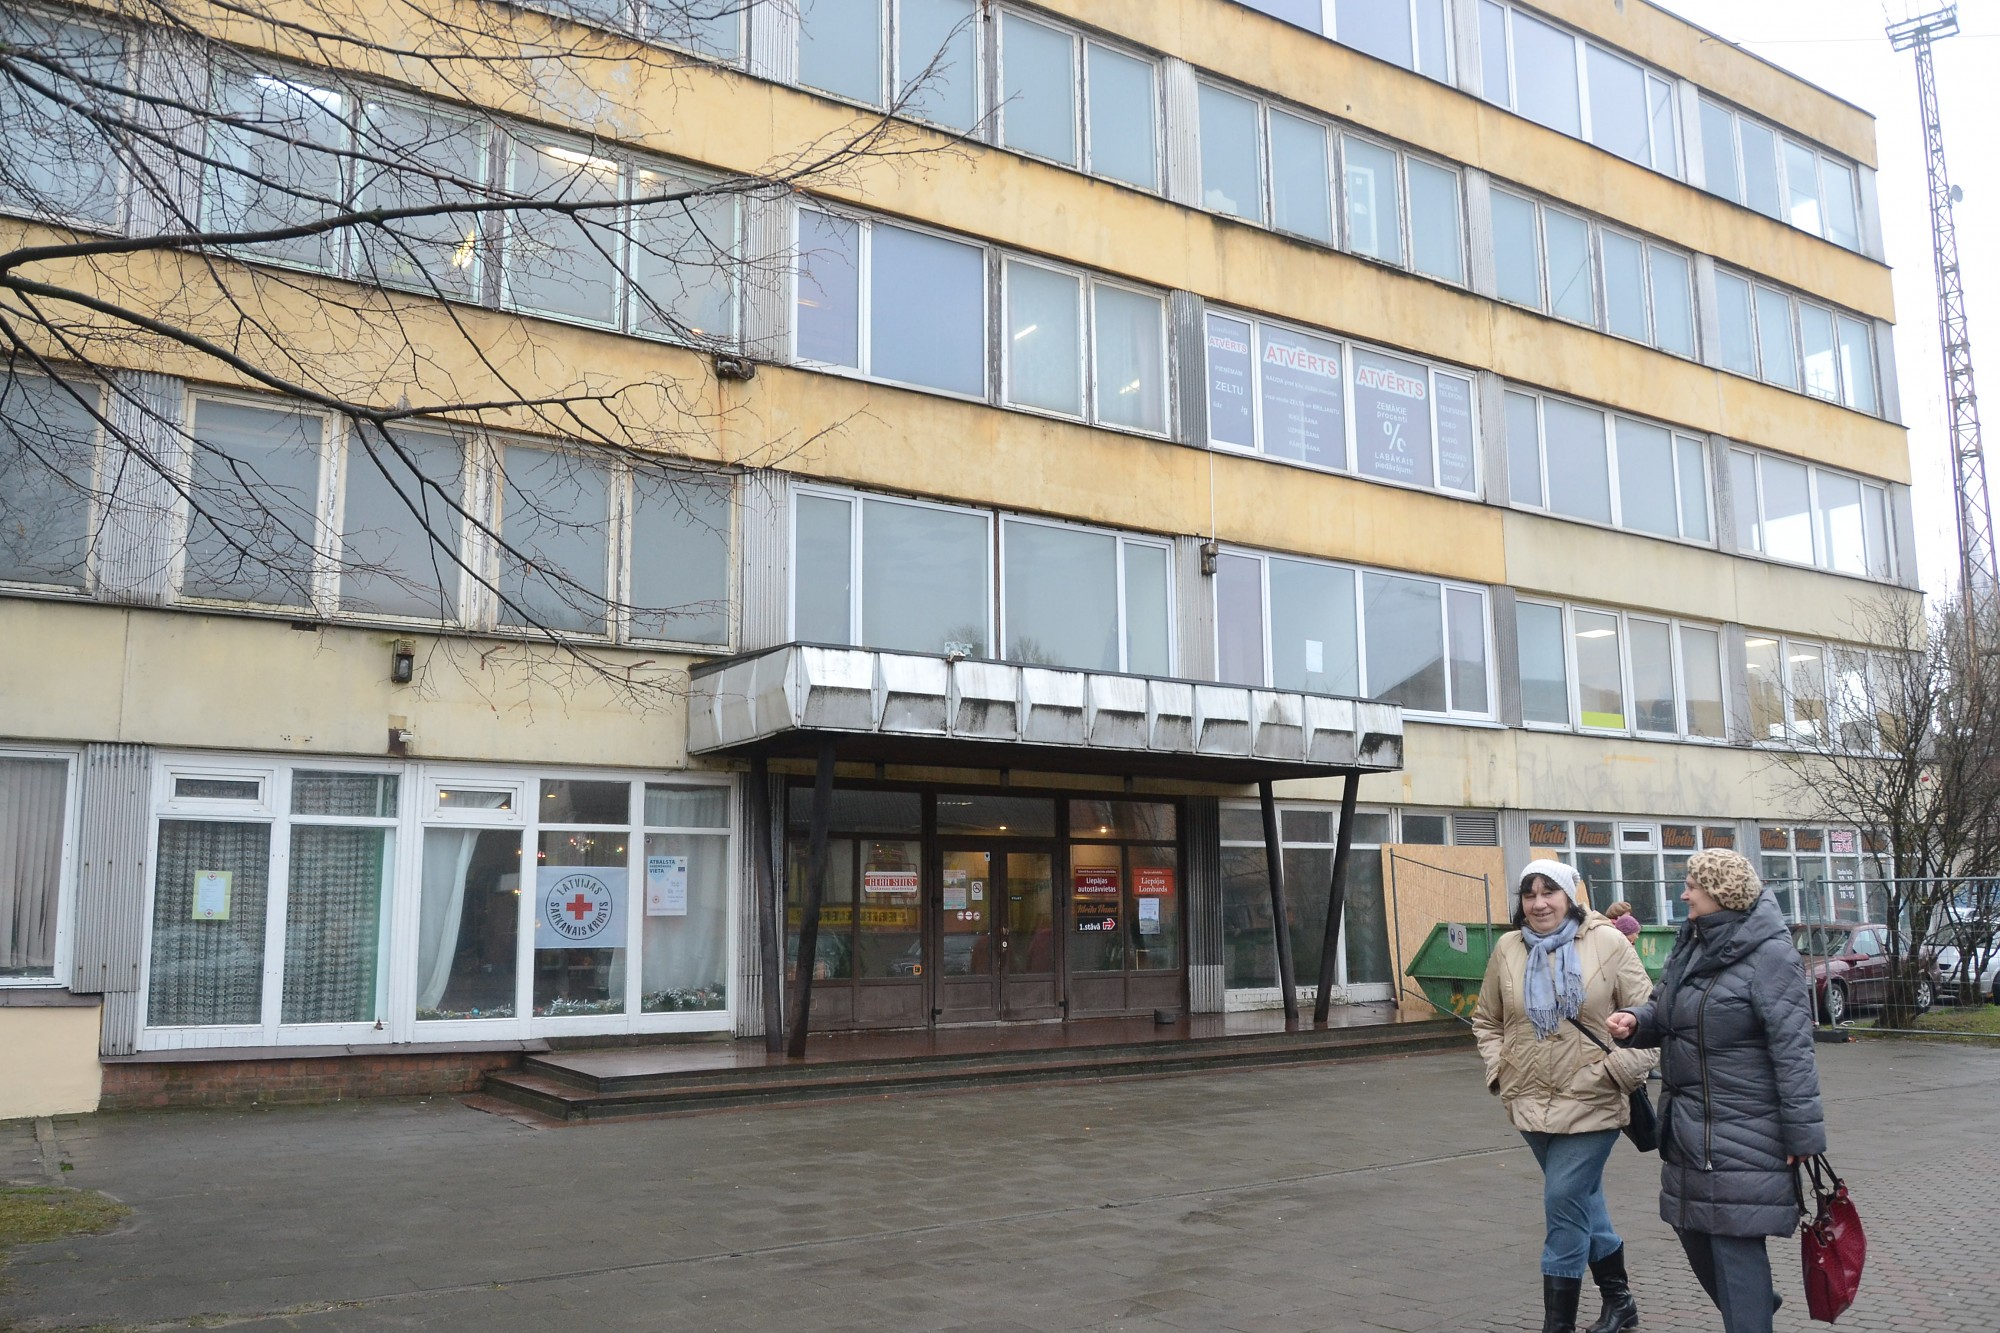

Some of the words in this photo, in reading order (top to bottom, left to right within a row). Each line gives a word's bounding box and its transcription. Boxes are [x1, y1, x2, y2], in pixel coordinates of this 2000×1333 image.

[1208, 337, 1247, 353] ATVĒRTS
[1266, 345, 1337, 376] ATVĒRTS
[1215, 381, 1244, 396] ZELTU
[1359, 369, 1424, 397] ATVĒRTS
[1376, 401, 1408, 416] ZEMĀKIE
[1376, 411, 1408, 424] procenti
[556, 878, 603, 896] LATVIJAS
[1086, 877, 1108, 885] Liepājas
[1141, 877, 1165, 885] Liepājas
[1077, 885, 1117, 893] autostāvvietas
[550, 901, 587, 936] SARKANAIS
[587, 901, 609, 933] KRUSTS
